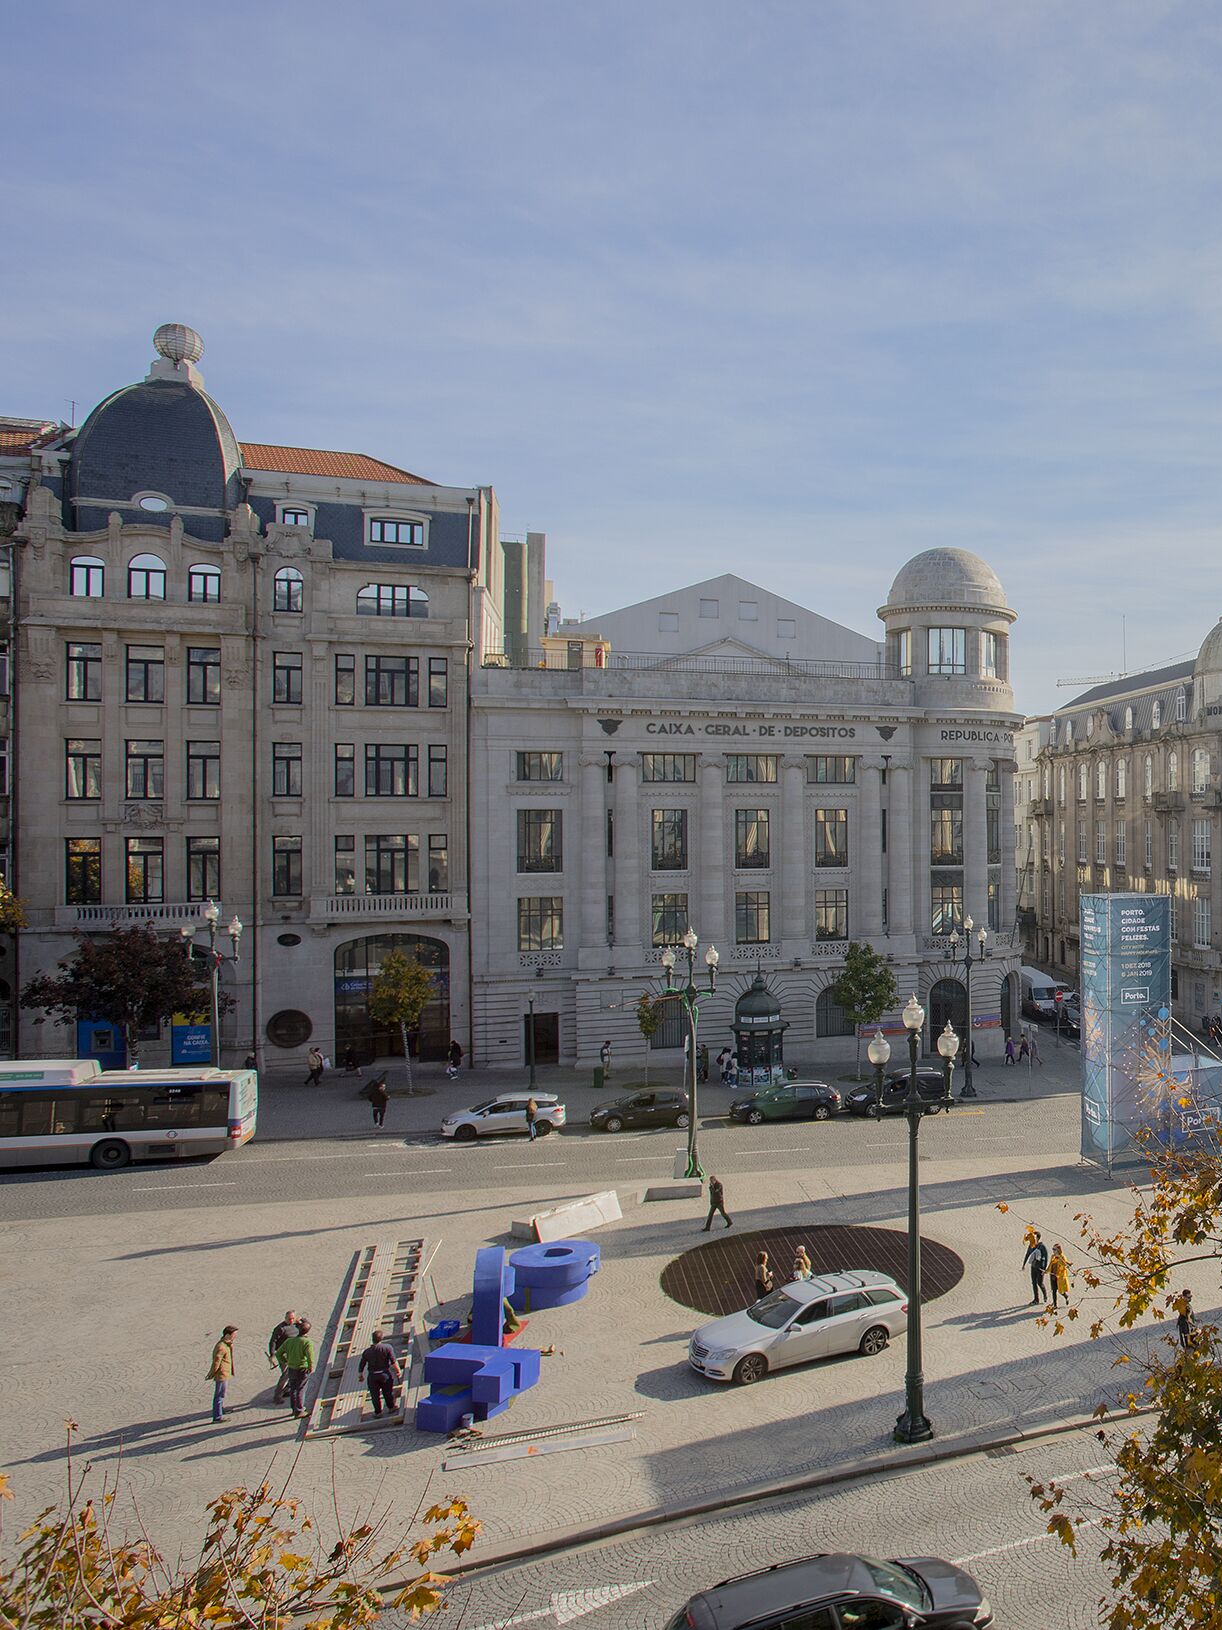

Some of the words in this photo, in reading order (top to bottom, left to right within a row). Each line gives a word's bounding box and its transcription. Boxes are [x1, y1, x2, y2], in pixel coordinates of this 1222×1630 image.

[646, 722, 695, 735] CAIXA
[705, 724, 750, 737] GERAL
[758, 725, 775, 737] DE
[1137, 961, 1151, 969] 2018
[1124, 991, 1146, 1000] Porto.
